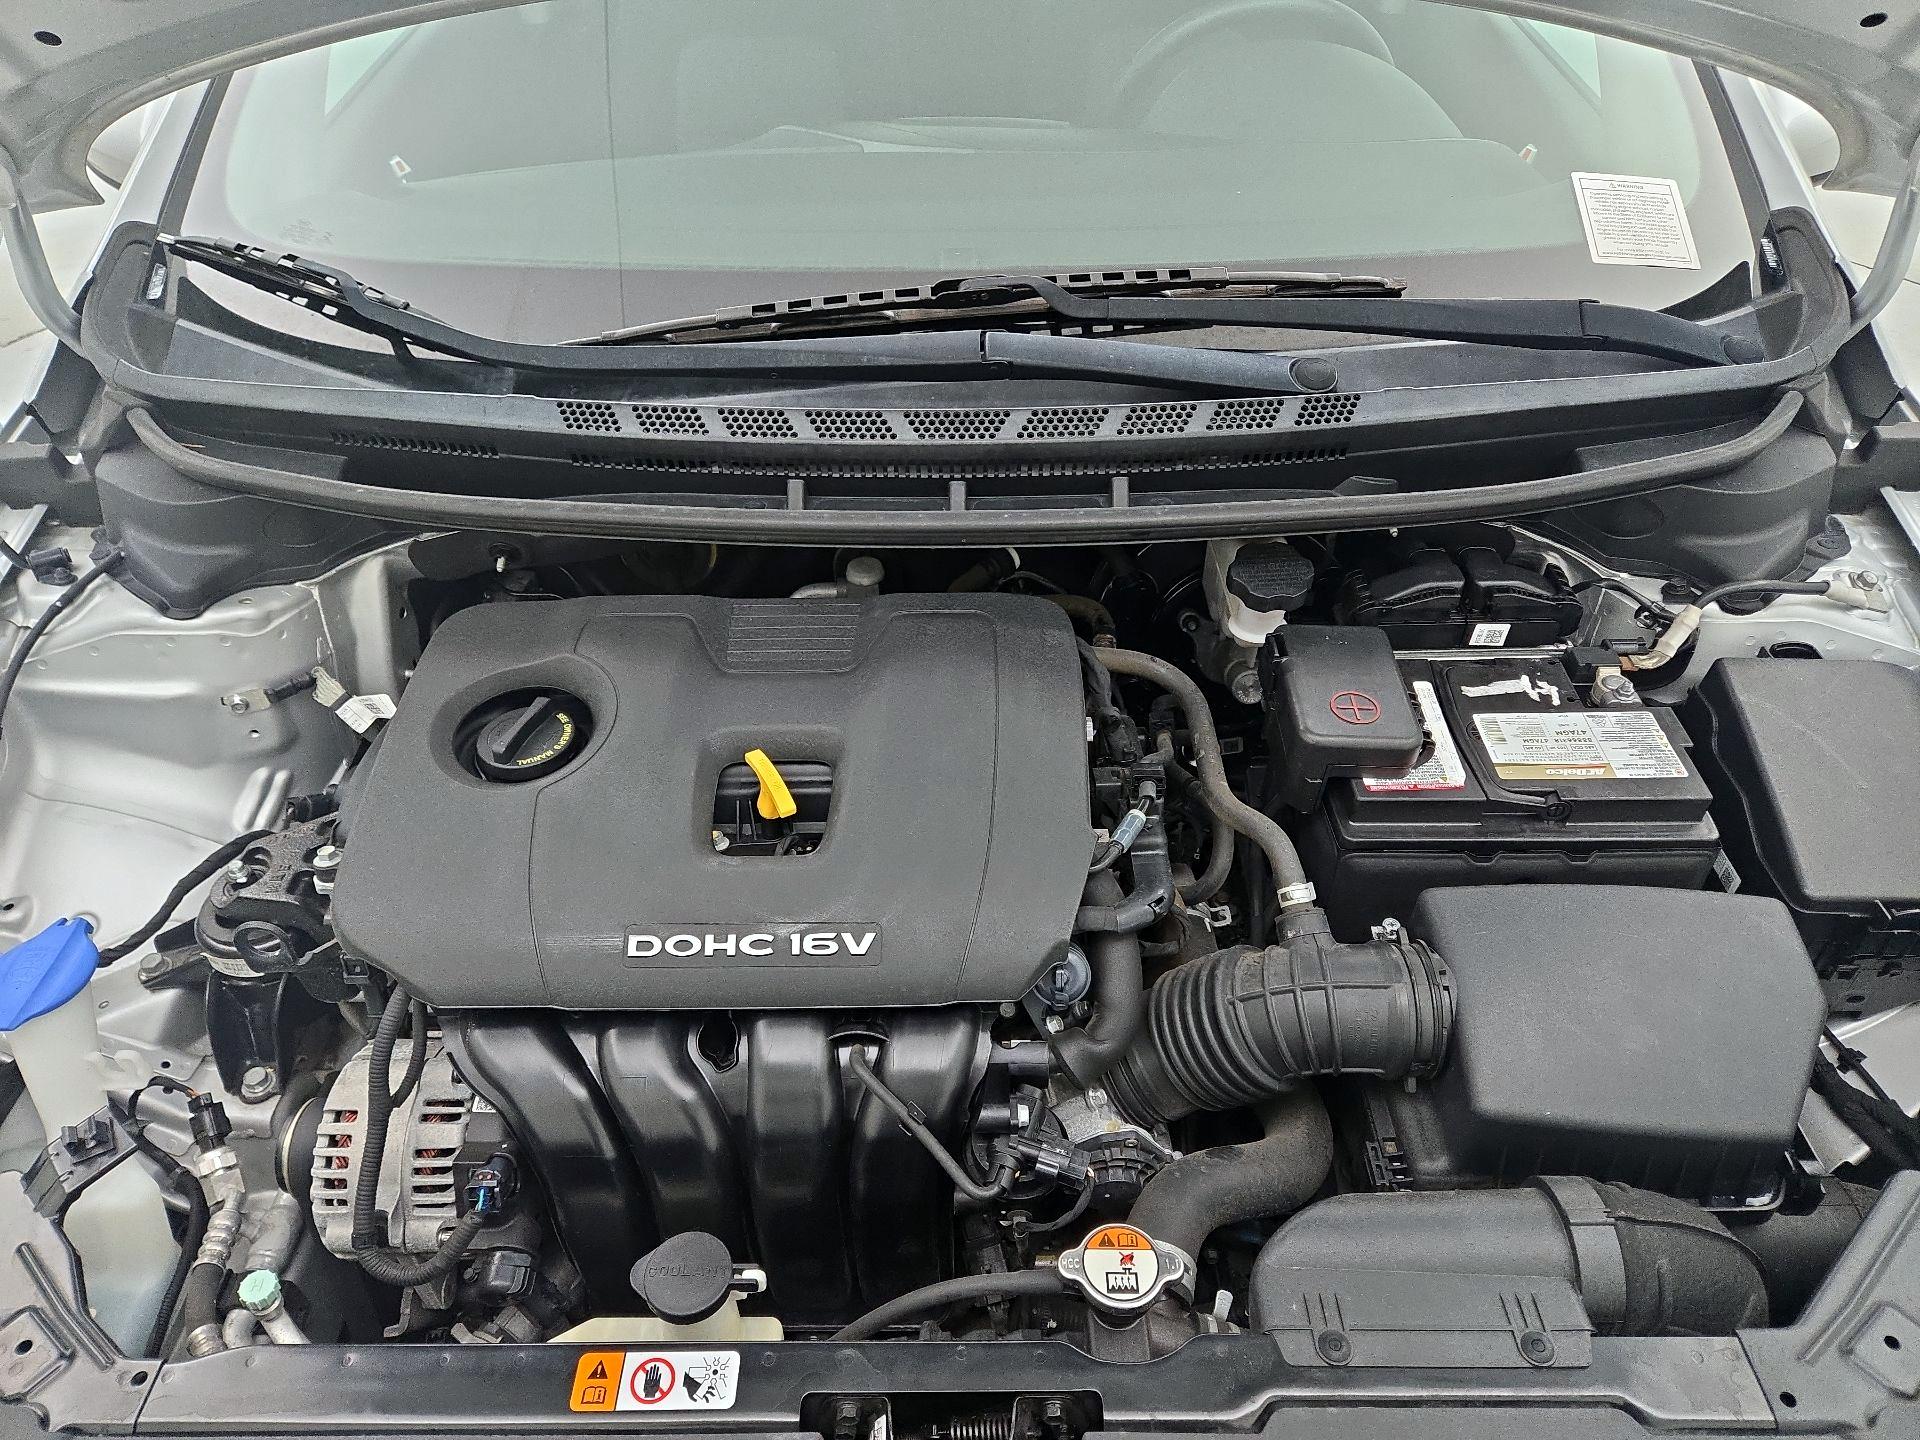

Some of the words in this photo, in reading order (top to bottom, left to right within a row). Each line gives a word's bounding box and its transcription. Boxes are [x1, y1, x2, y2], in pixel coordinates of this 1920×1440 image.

[556, 713, 570, 724] SEE
[553, 723, 573, 750] OWNER'S
[516, 749, 554, 766] MANUAL
[1545, 767, 1606, 776] ACDelco
[627, 933, 775, 958] DOHC
[790, 932, 877, 957] 16V
[648, 1262, 729, 1279] COOLANT
